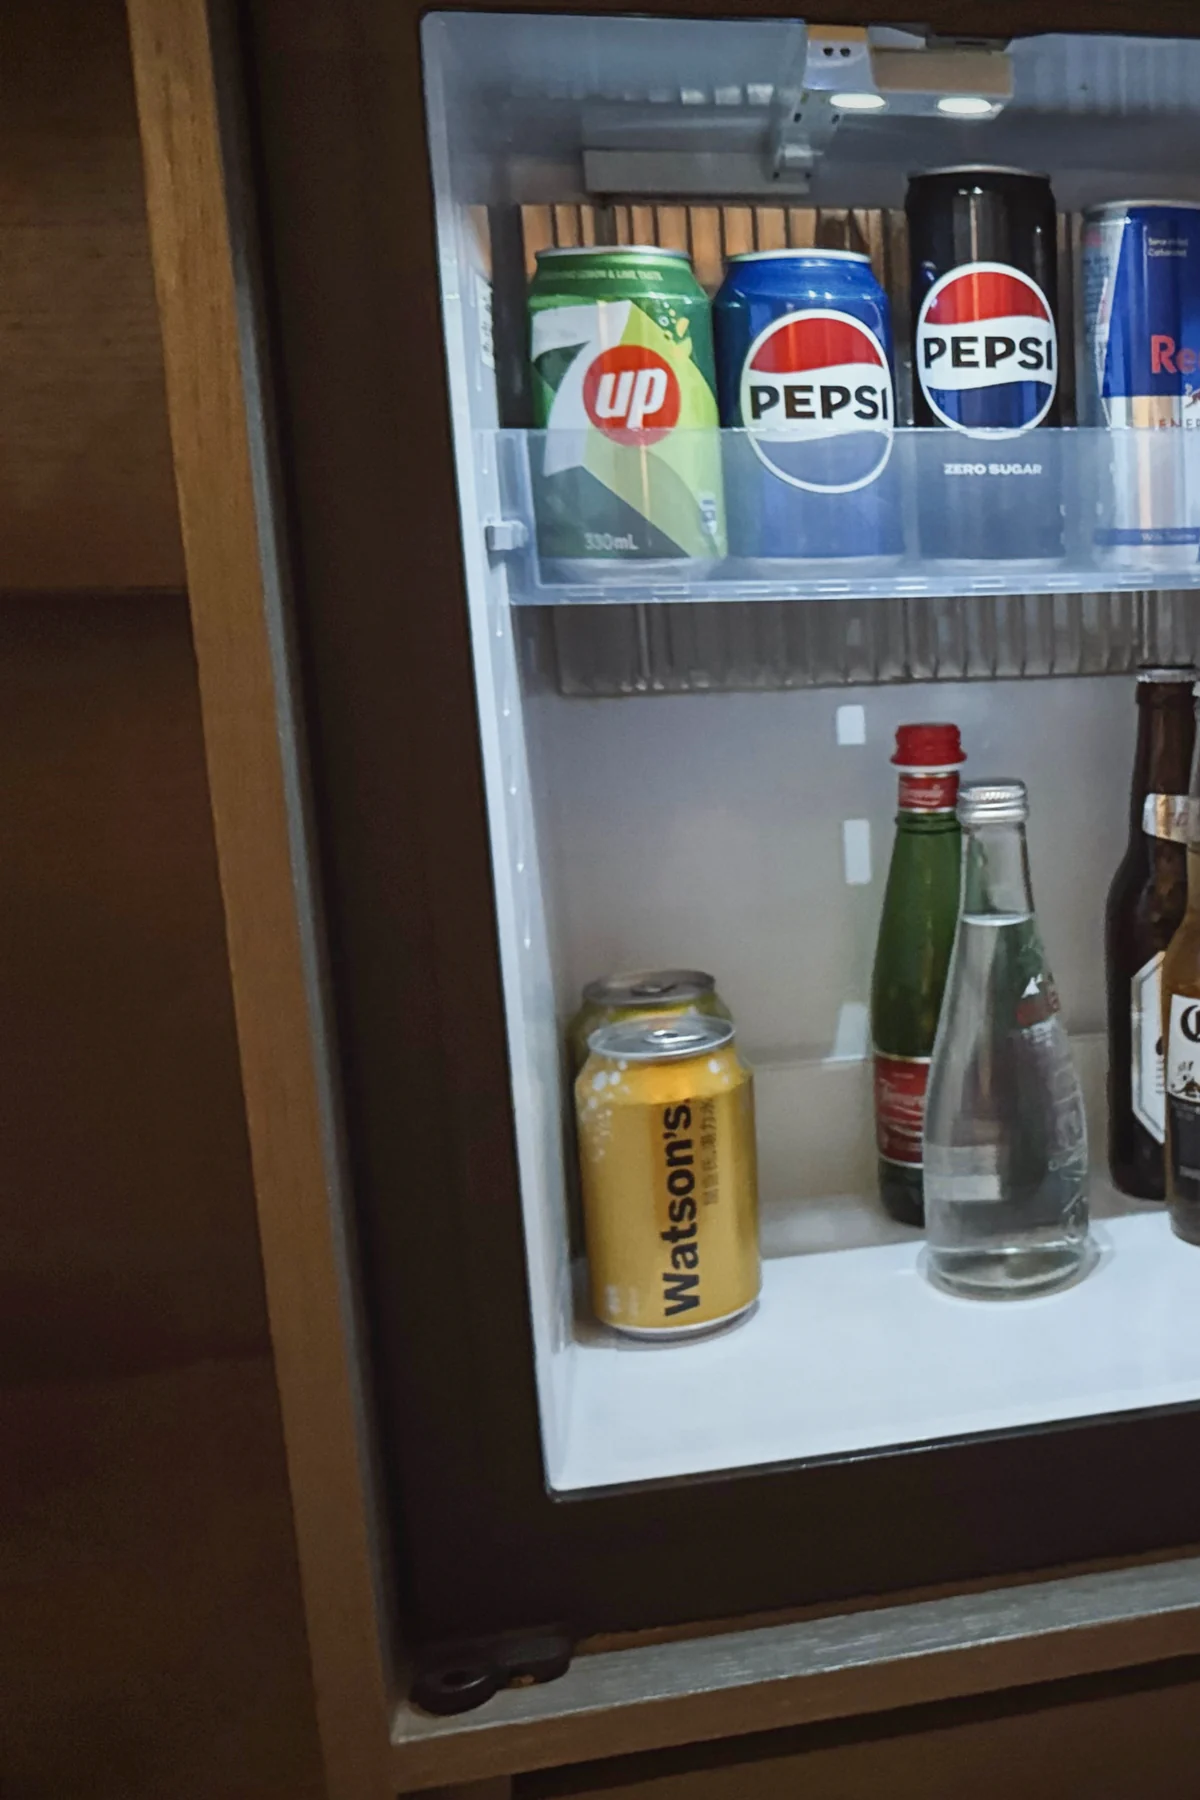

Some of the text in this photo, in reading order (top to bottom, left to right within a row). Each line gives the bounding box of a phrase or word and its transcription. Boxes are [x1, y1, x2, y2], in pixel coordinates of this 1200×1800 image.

[923, 336, 1053, 371] PEPSI
[749, 384, 889, 421] PEPSI
[944, 463, 1042, 476] ZERO SUGAR
[660, 1104, 701, 1317] Watson's
